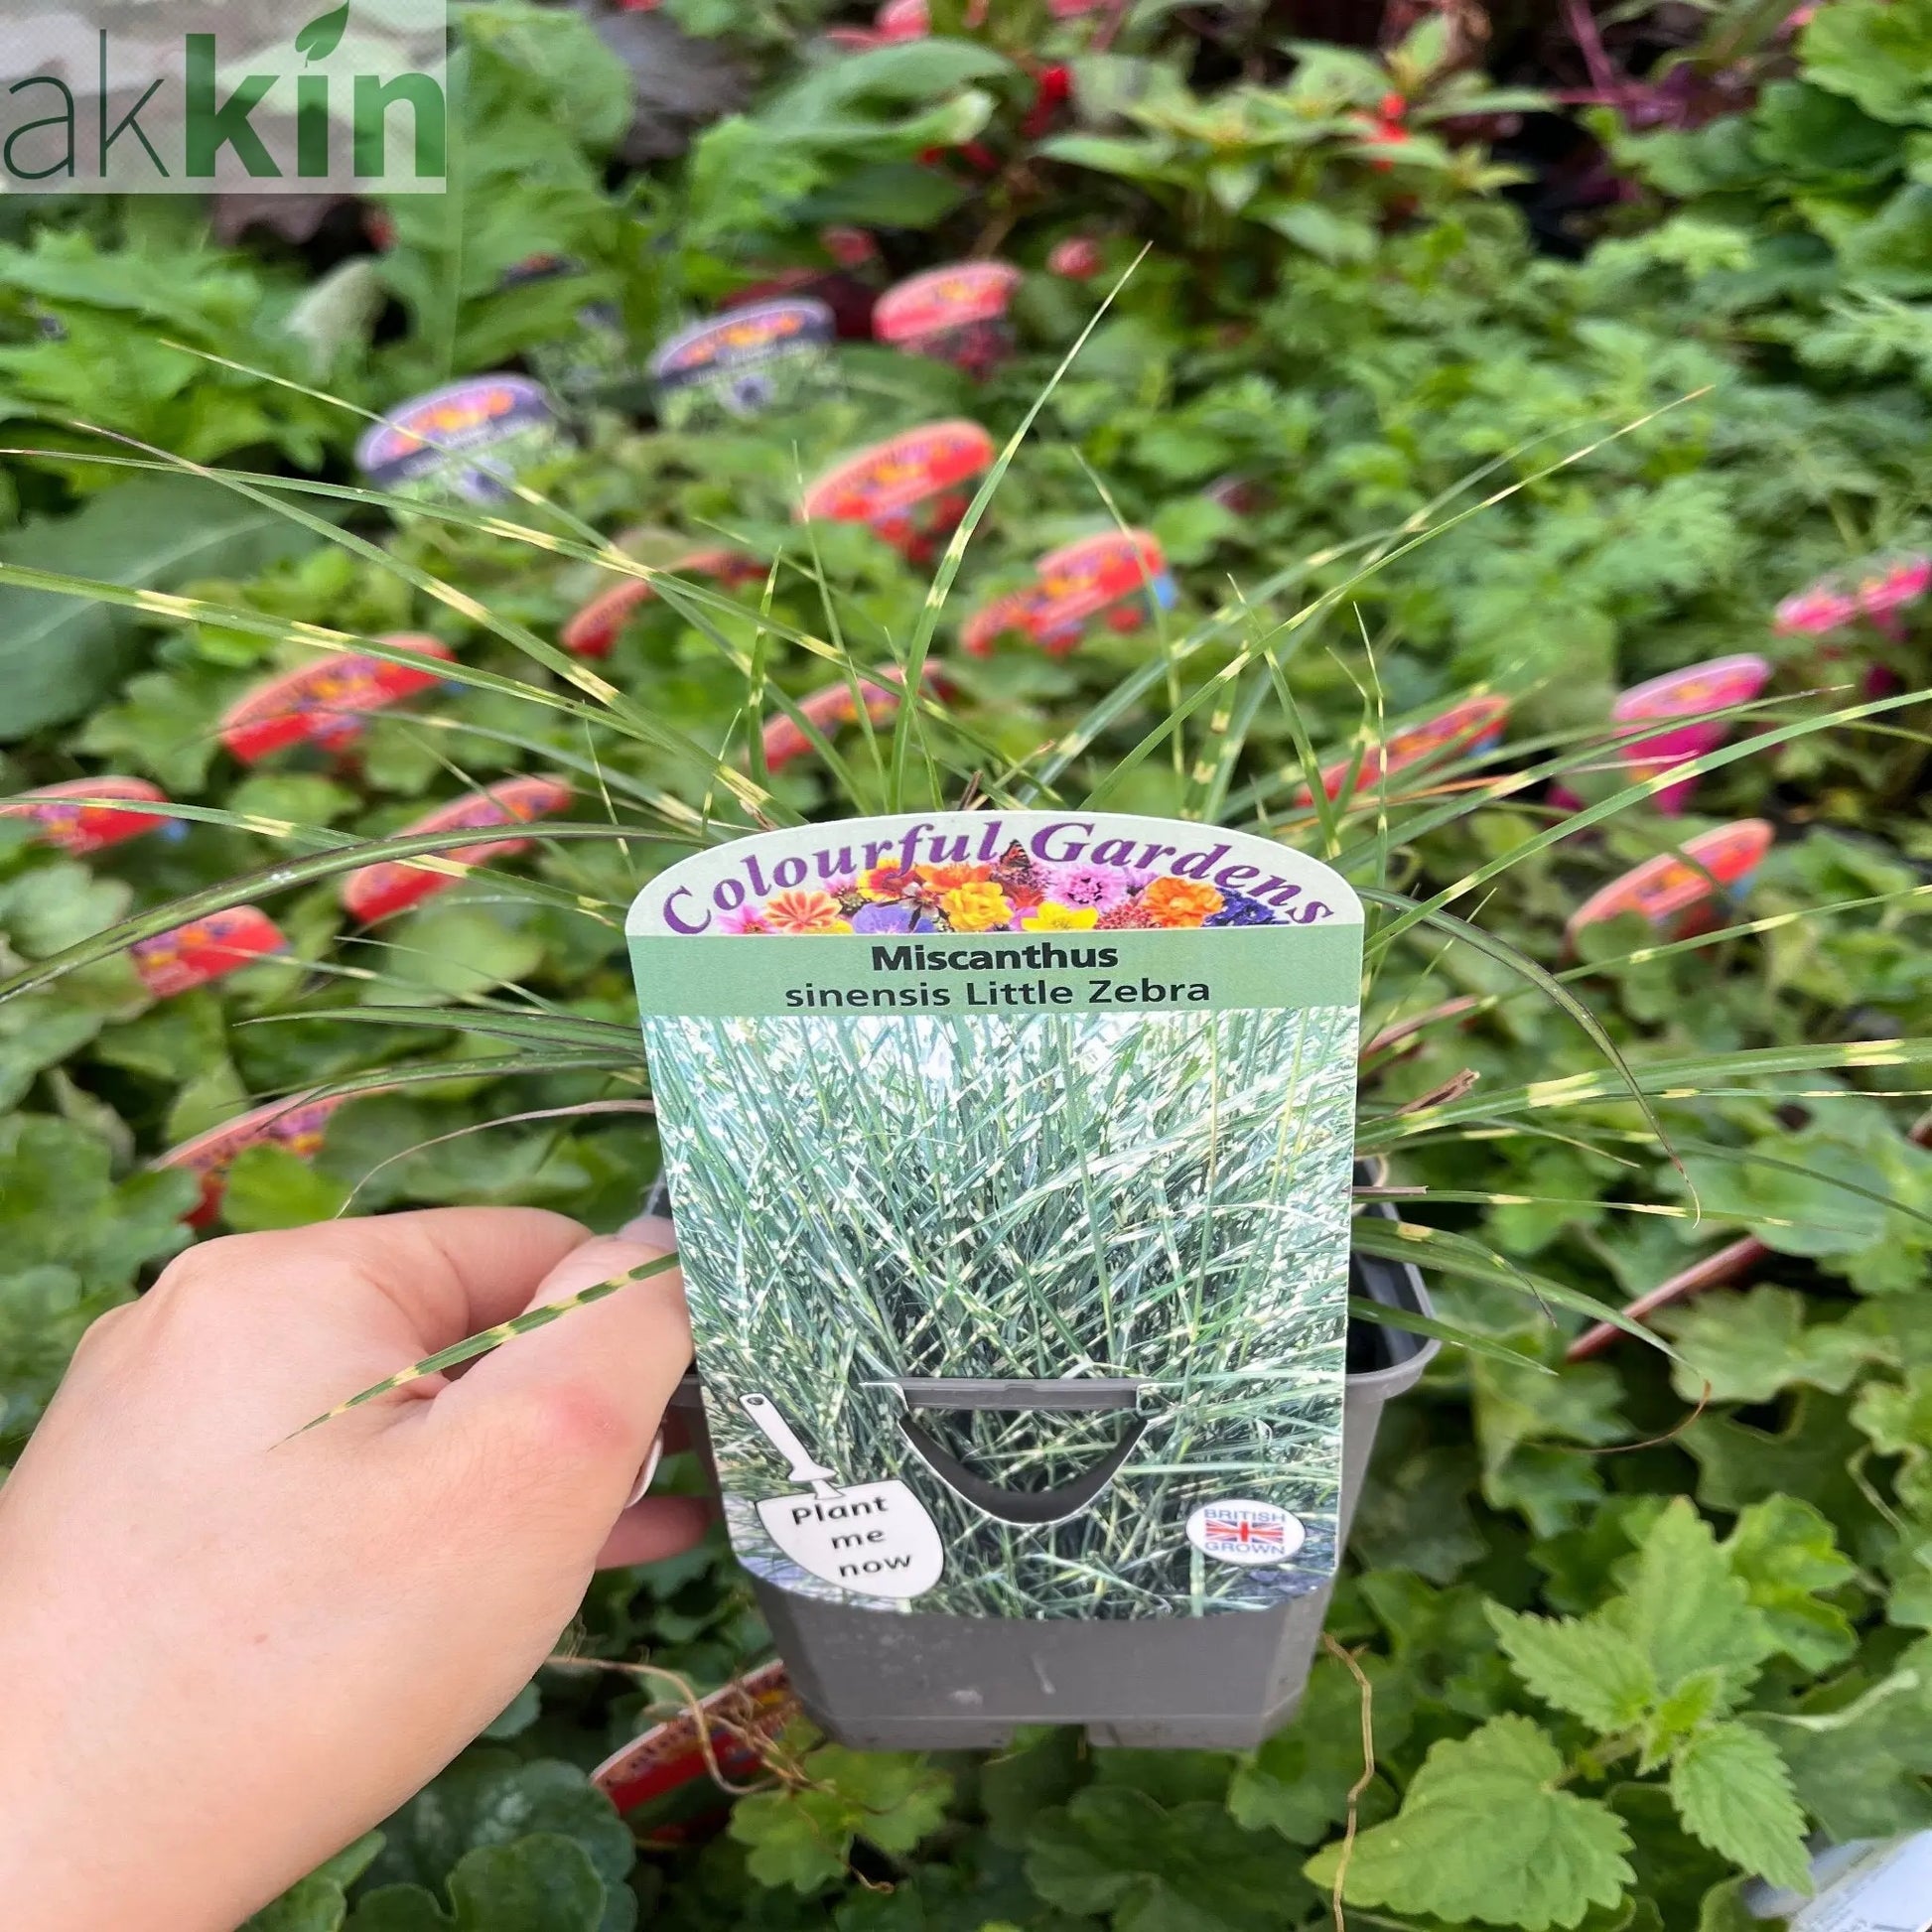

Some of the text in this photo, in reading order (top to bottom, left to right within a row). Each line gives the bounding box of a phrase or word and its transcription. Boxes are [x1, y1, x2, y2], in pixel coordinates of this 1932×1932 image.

[662, 821, 1001, 934] Colourful
[1031, 822, 1334, 925] Gardens
[872, 942, 1119, 972] Miscanthus
[785, 979, 1211, 1008] sinensis Little Zebra
[792, 1496, 888, 1525] Plant
[1204, 1508, 1286, 1522] BRITISH
[831, 1529, 885, 1550] me
[1204, 1541, 1286, 1555] GROWN
[839, 1554, 911, 1578] now
